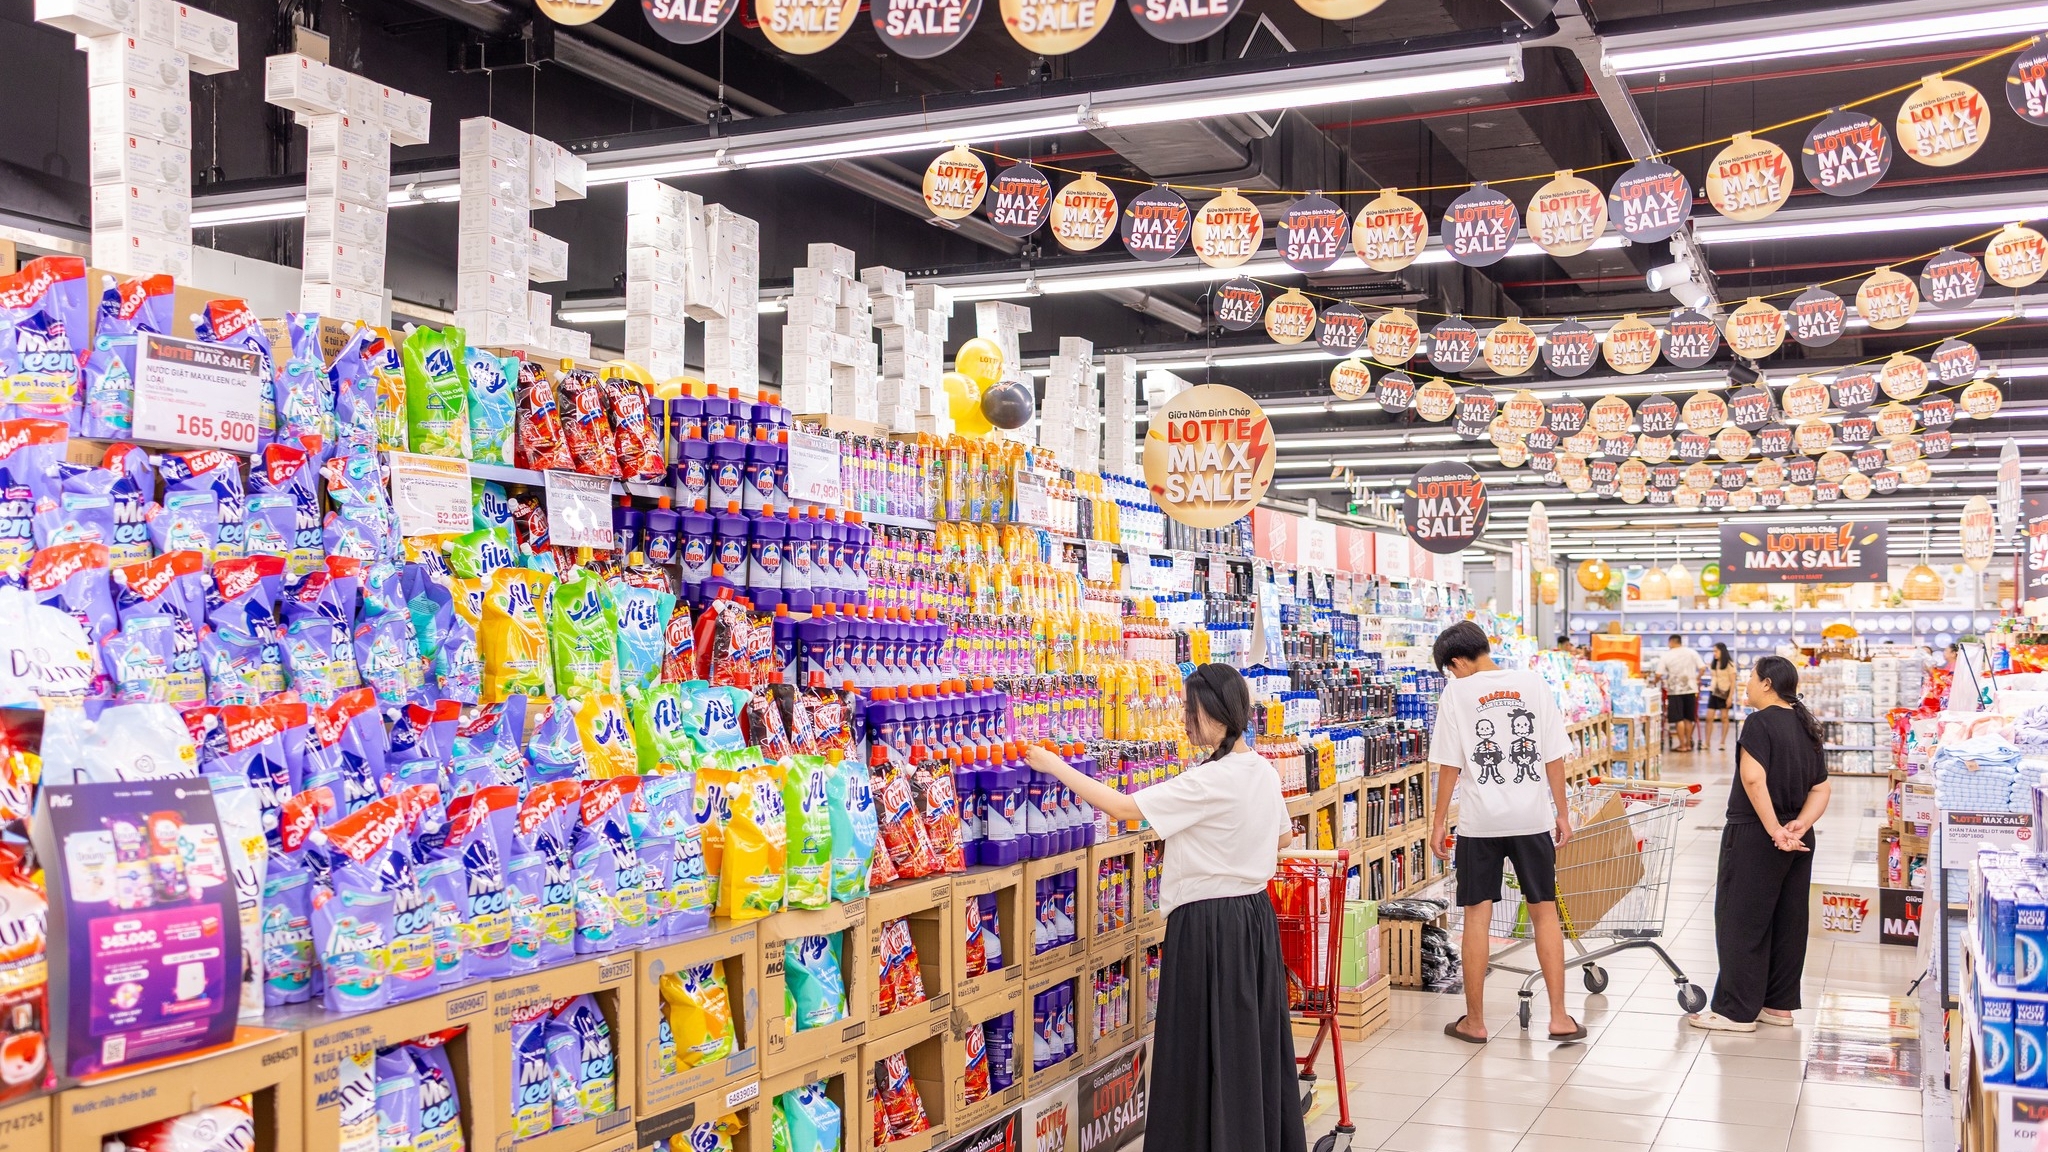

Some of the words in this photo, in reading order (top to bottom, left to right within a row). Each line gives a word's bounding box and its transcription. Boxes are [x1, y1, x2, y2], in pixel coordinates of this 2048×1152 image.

[771, 8, 840, 32] SALE
[885, 8, 960, 36] SALE
[1018, 4, 1095, 34] SALE
[1910, 97, 1967, 123] LOTTE
[1914, 111, 1973, 140] MAX
[1813, 128, 1870, 154] LOTTE
[1918, 126, 1978, 158] SALE
[1817, 141, 1873, 170] MAX
[938, 166, 977, 179] LOTTE
[1719, 156, 1774, 179] LOTTE
[1820, 158, 1881, 187] SALE
[935, 178, 976, 194] MAX
[1000, 182, 1040, 194] LOTTE
[1722, 170, 1777, 196] MAX
[932, 192, 974, 209] SALE
[997, 194, 1039, 210] MAX
[1540, 194, 1591, 212] LOTTE
[1724, 185, 1781, 212] SALE
[994, 208, 1038, 226] SALE
[1135, 206, 1178, 219] LOTTE
[1541, 208, 1592, 228] MAX
[1132, 218, 1177, 234] MAX
[1289, 217, 1336, 229] LOTTE
[1130, 234, 1176, 250] SALE
[1289, 227, 1335, 244] MAX
[1541, 224, 1594, 245] SALE
[1288, 243, 1336, 260] SALE
[1930, 263, 1972, 278] LOTTE
[1932, 271, 1973, 291] MAX
[1224, 290, 1256, 300] LOTTE
[1933, 285, 1977, 301] SALE
[1222, 299, 1254, 311] MAX
[1220, 309, 1252, 322] SALE
[1671, 325, 1708, 335] LOTTE
[1671, 334, 1708, 346] MAX
[158, 344, 192, 361] LOTTE
[194, 353, 222, 365] MAX
[222, 356, 250, 369] SALE
[1670, 345, 1709, 358] SALE
[1937, 351, 1968, 363] LOTTE
[1939, 358, 1972, 370] MAX
[1941, 368, 1975, 381] SALE
[1511, 403, 1536, 411] LOTTE
[1551, 412, 1578, 422] MAX
[177, 414, 255, 442] 165,900
[1168, 418, 1250, 443] LOTTE
[1551, 421, 1579, 431] SALE
[1167, 441, 1250, 472] MAX
[590, 481, 604, 490] SALE
[719, 478, 737, 487] DUCK
[758, 480, 774, 489] DUCK
[1165, 472, 1251, 503] SALE
[1418, 480, 1472, 498] LOTTE
[1418, 497, 1472, 517] MAX
[1417, 516, 1474, 538] SALE
[1767, 534, 1837, 551] LOTTE
[650, 550, 668, 558] DUCK
[686, 552, 704, 561] DUCK
[722, 555, 739, 563] DUCK
[763, 557, 779, 565] DUCK
[1745, 552, 1798, 568] MAX
[1802, 550, 1861, 567] SALE
[1822, 896, 1860, 907] LOTTE
[1822, 906, 1860, 919] MAX
[2018, 909, 2045, 918] WHITE
[2019, 916, 2045, 925] NOW
[1822, 918, 1861, 932] SALE
[1984, 1001, 2011, 1009] WHITE
[1985, 1008, 2011, 1017] NOW
[1093, 1071, 1133, 1118] LOTTE
[1036, 1109, 1063, 1138] LOTTE
[1081, 1112, 1111, 1151] MAX
[1113, 1092, 1144, 1134] SALE
[1037, 1126, 1063, 1152] MAX
